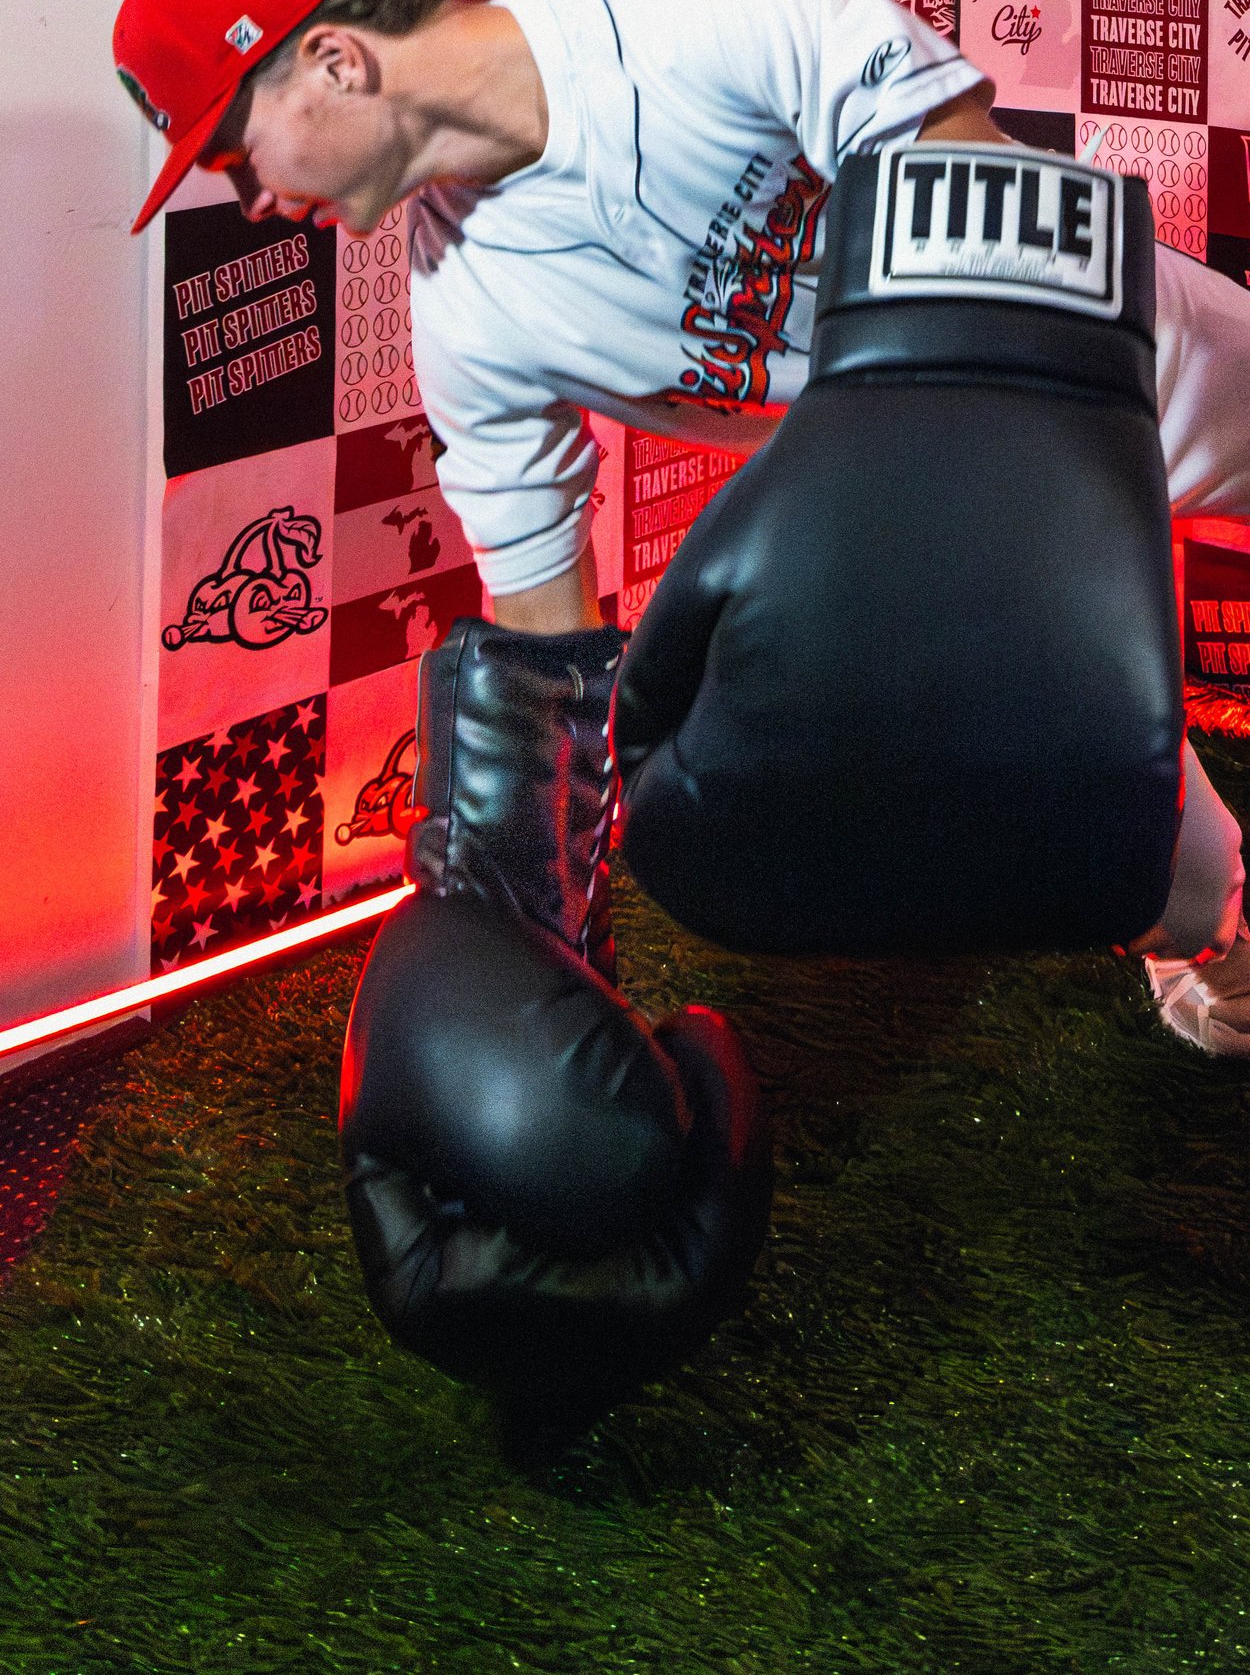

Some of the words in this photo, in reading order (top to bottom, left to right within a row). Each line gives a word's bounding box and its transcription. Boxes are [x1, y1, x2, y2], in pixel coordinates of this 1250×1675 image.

[991, 5, 1042, 55] City
[1091, 15, 1164, 47] TRAVERSE
[1168, 19, 1201, 49] CITY
[1091, 78, 1163, 112] TRAVERSE
[1167, 83, 1200, 116] CITY
[903, 162, 1093, 259] TITLE
[173, 271, 213, 320] PIT
[215, 233, 309, 302] SPITTERS
[181, 319, 222, 367] PIT
[222, 279, 316, 349] SPITTERS
[187, 366, 227, 415] PIT
[228, 326, 322, 396] SPITTERS
[633, 454, 705, 504] TRAVERSE
[1190, 600, 1221, 633] PIT
[1196, 642, 1228, 674] PIT
